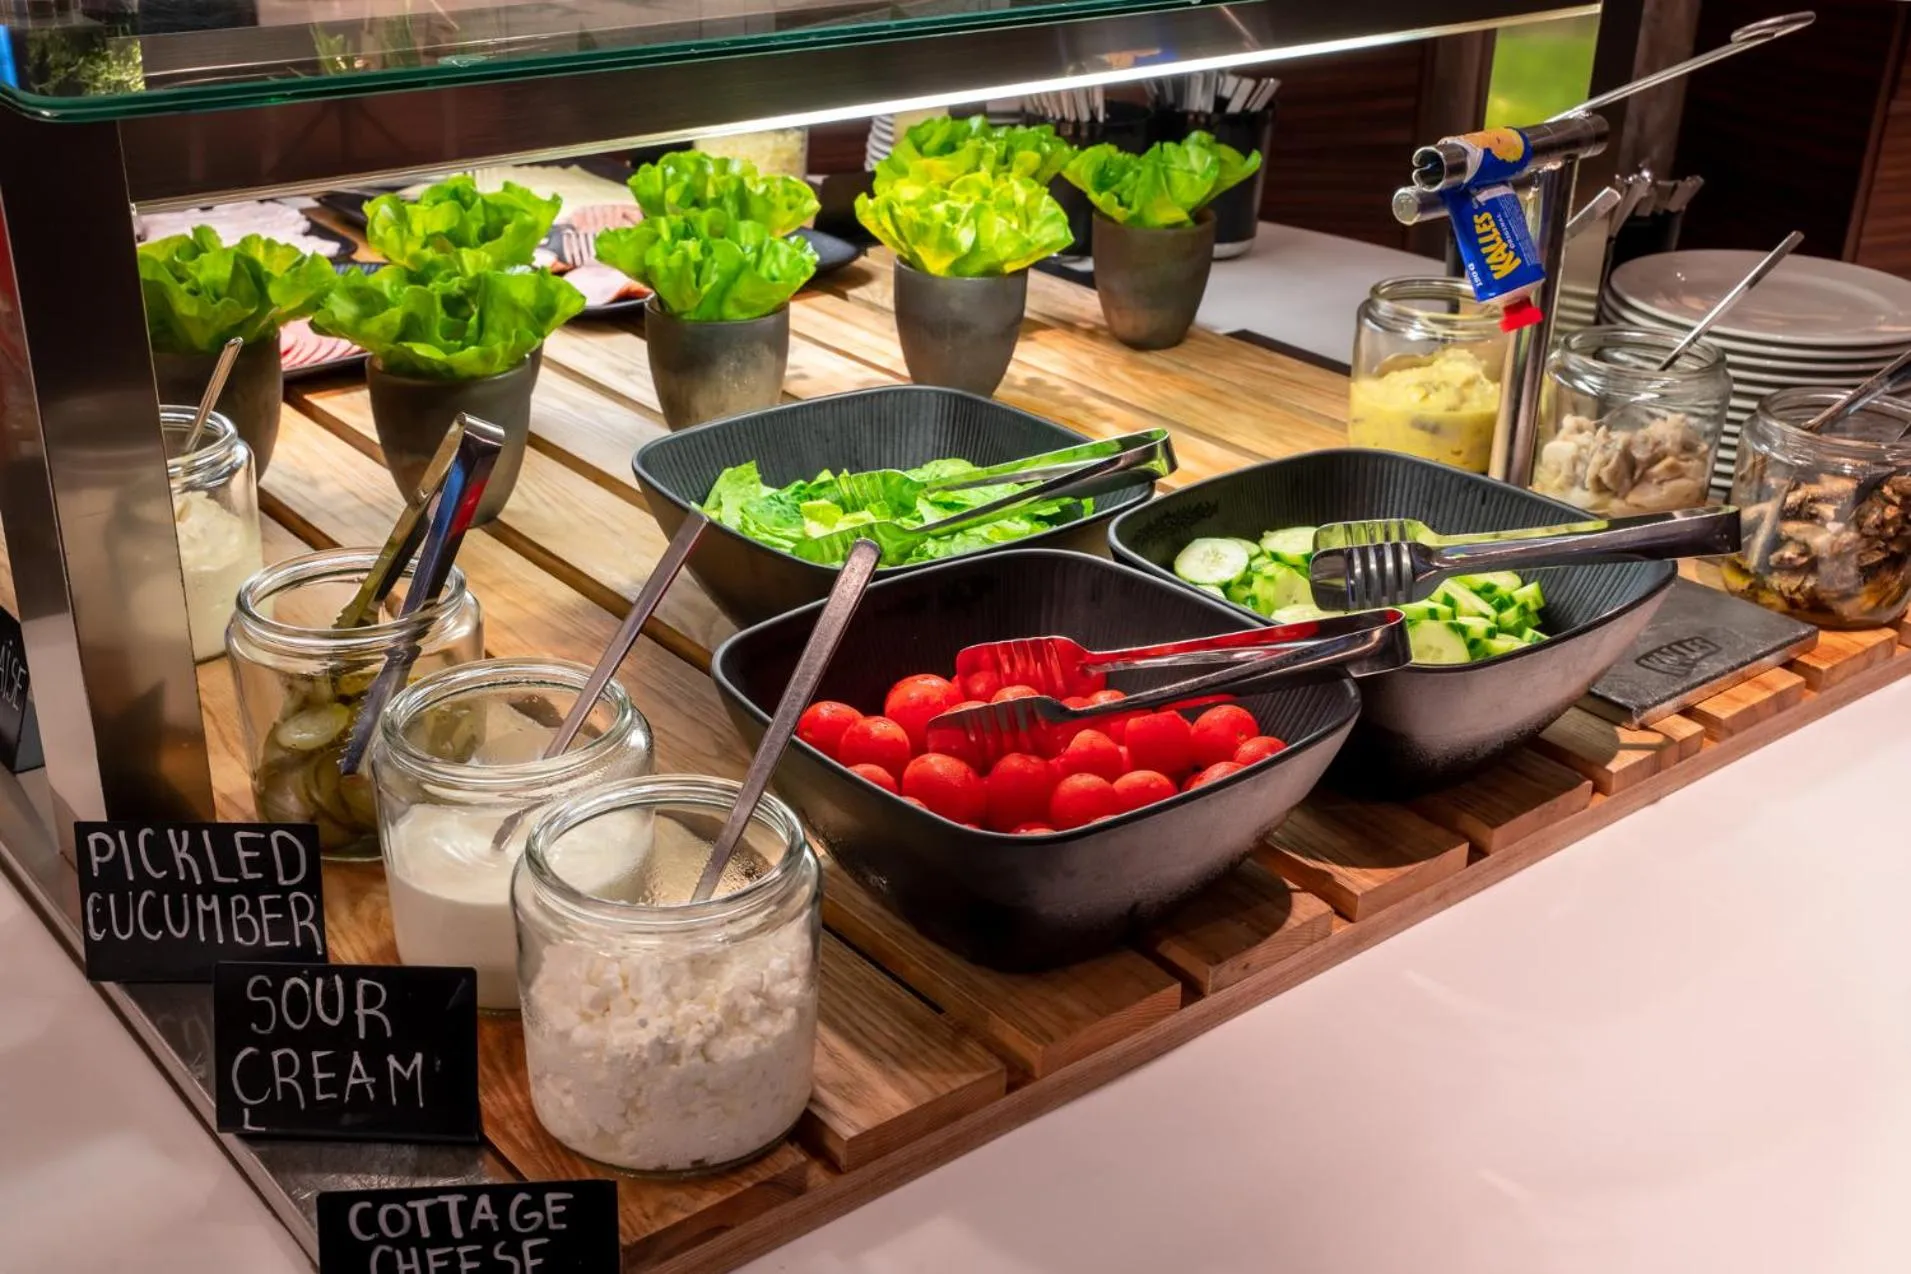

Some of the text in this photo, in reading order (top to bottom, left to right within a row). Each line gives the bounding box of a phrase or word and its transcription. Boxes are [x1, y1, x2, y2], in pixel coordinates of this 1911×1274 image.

[1473, 212, 1522, 280] KALLES
[1496, 212, 1516, 250] ORIGINAL
[87, 828, 307, 886] PICKLED
[87, 890, 323, 955] CUCUMBER
[246, 974, 392, 1039] SOUR
[231, 1047, 424, 1110] CREAM
[348, 1192, 574, 1241] COTTAGE
